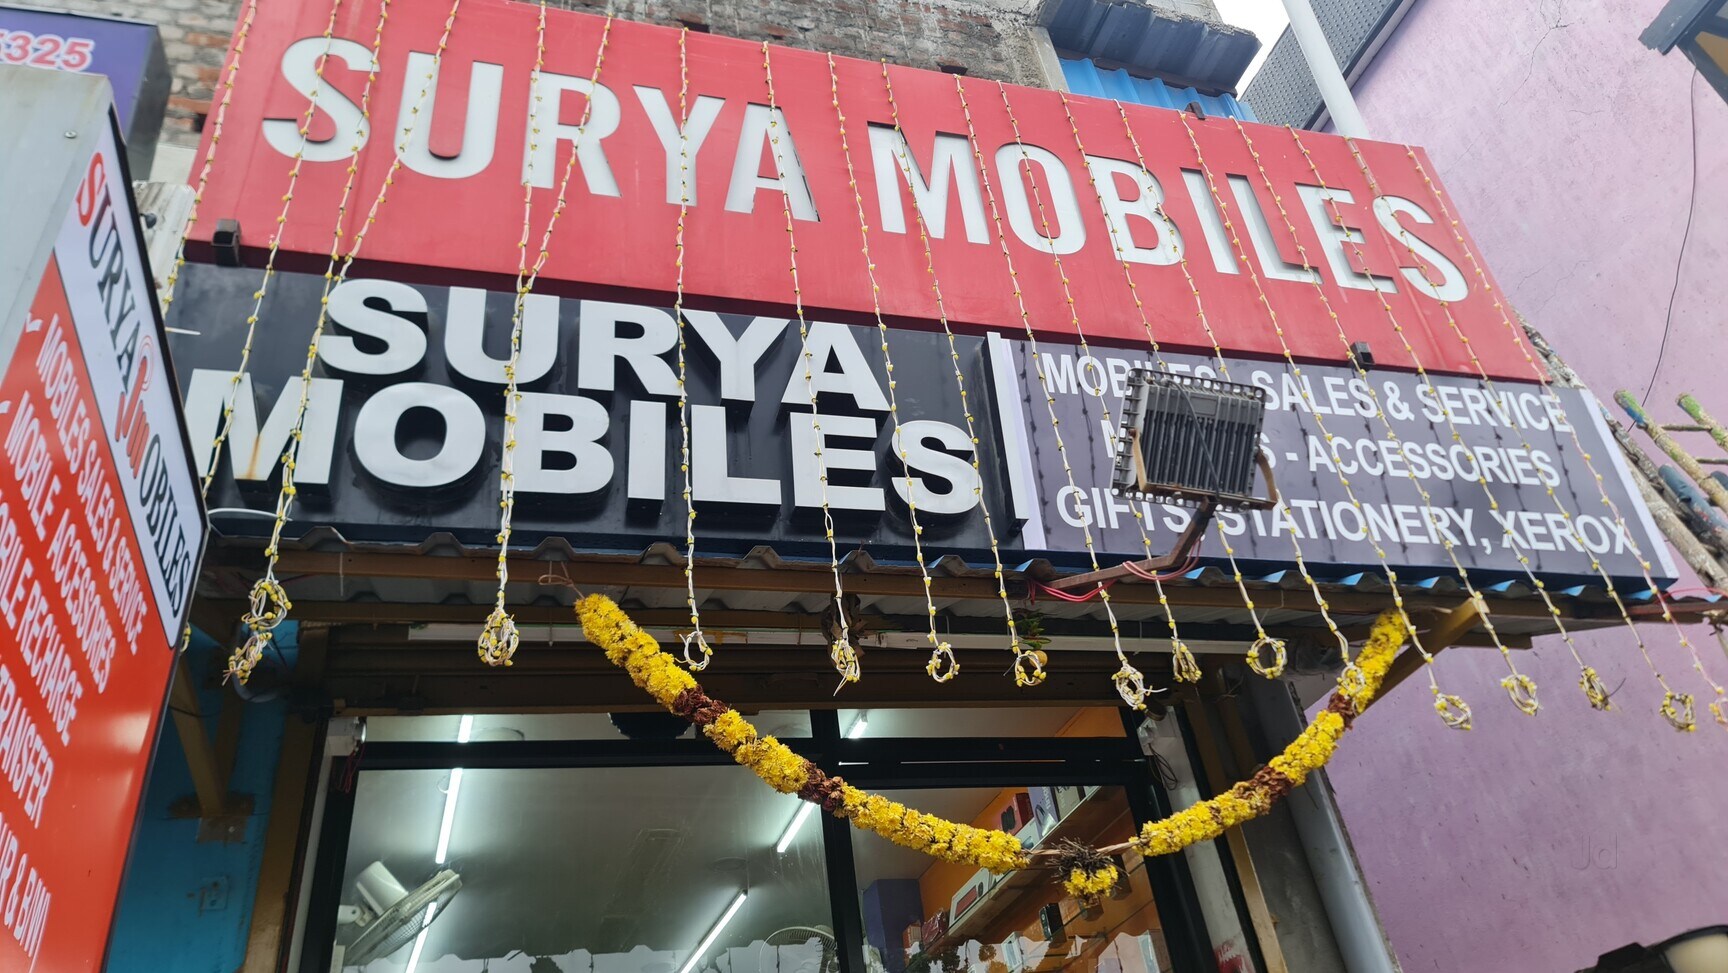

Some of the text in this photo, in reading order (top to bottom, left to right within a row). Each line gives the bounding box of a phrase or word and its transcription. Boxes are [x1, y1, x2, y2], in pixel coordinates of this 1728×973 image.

[0, 30, 94, 70] 325
[262, 36, 1469, 302] SURYA MOBILES
[76, 151, 140, 395] SURYA
[318, 278, 891, 412] SURYA
[184, 368, 984, 514] MOBILES
[1251, 369, 1379, 418] SALES
[1383, 380, 1415, 422] &
[1416, 383, 1572, 433] SERVICE
[1308, 435, 1561, 487] ACCESSORIES
[4, 390, 116, 694] MOBILE ACCESSORIES
[36, 313, 148, 656] MOBILES SALES & SERVICE
[1488, 509, 1642, 556] XEROX
[0, 488, 83, 747] BILE RECHARGE
